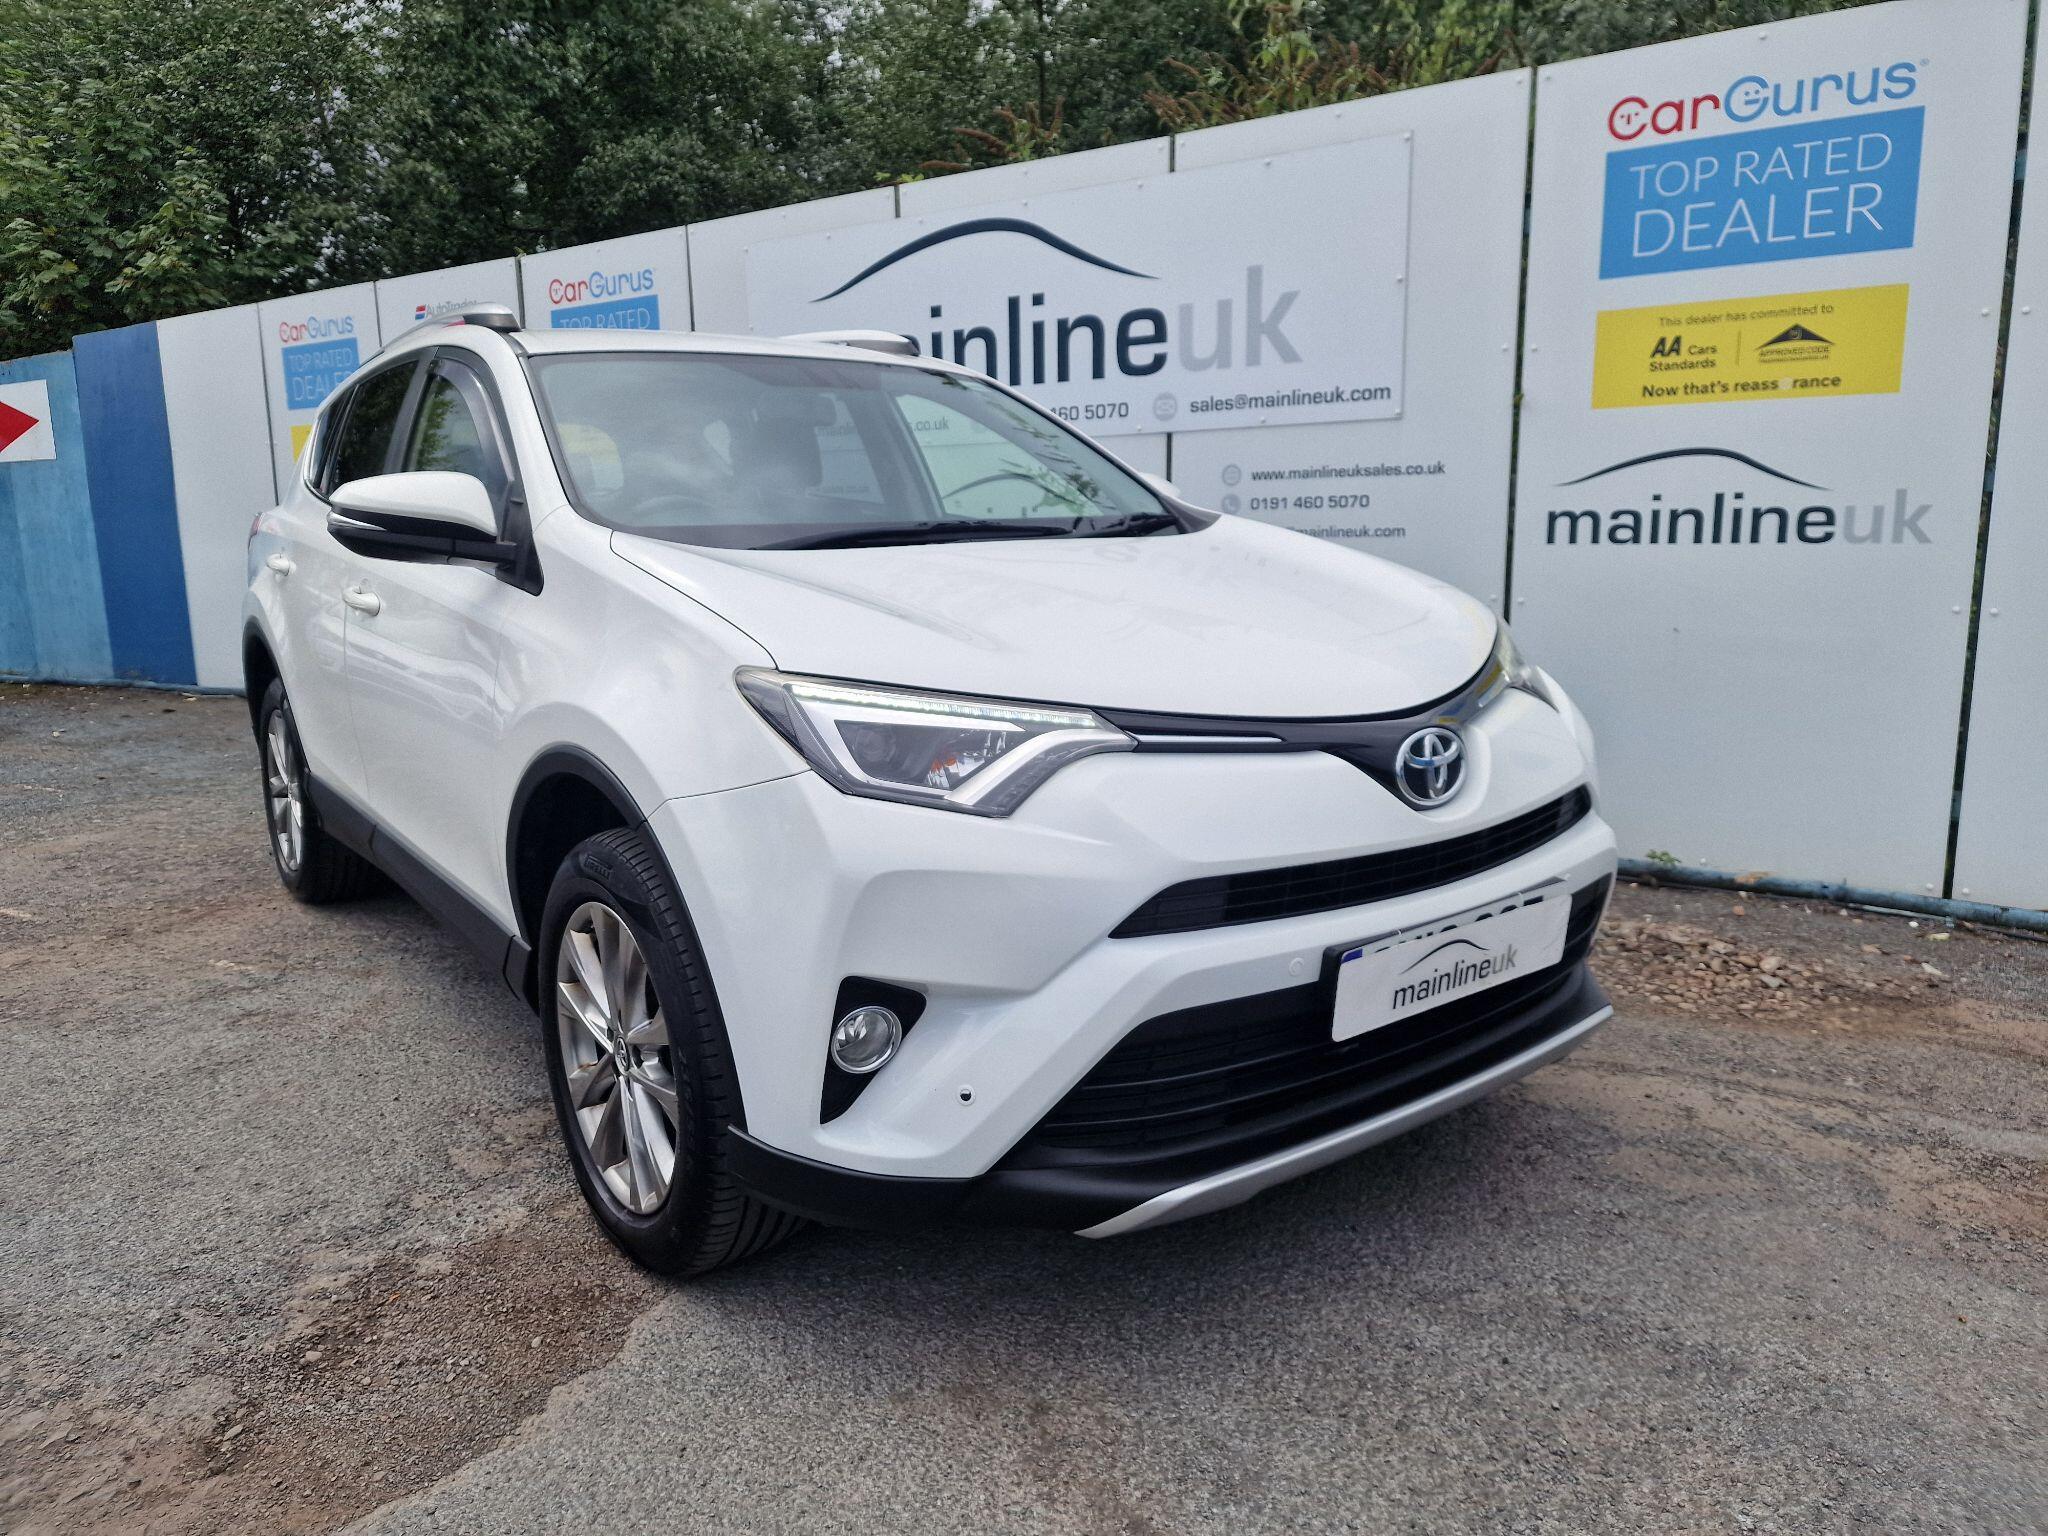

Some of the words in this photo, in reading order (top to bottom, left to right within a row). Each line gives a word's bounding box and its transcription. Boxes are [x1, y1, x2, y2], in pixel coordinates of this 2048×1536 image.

[1608, 60, 1918, 141] CarGurus
[1629, 155, 1719, 200] TOP
[1734, 132, 1893, 188] RATED
[1632, 182, 1885, 258] DEALER
[549, 269, 654, 305] CarGurus
[901, 264, 1302, 386] inlineuk
[1659, 316, 1682, 327] This
[1685, 314, 1722, 325] dealer
[1726, 312, 1747, 322] has
[1750, 304, 1818, 320] committed
[1821, 304, 1834, 314] to
[279, 316, 354, 344] CarGurus
[288, 353, 312, 372] TOP
[313, 348, 353, 369] RATED
[1651, 335, 1682, 358] AA
[1687, 344, 1718, 356] Cars
[1649, 357, 1717, 372] Standards
[292, 370, 353, 400] DEALE
[1190, 385, 1391, 413] sales@mainlineuk.com
[1642, 384, 1678, 398] Now
[1683, 380, 1729, 396] that's
[1734, 376, 1841, 392] reassrance
[1085, 402, 1129, 420] 5070
[1252, 460, 1446, 481] www.mainlineuksales.co.uk
[1250, 497, 1288, 511] 0191
[1293, 496, 1324, 509] 460
[1328, 494, 1370, 508] 5070
[1546, 488, 1933, 545] mainlineuk
[1392, 943, 1518, 1010] mainlineuk
